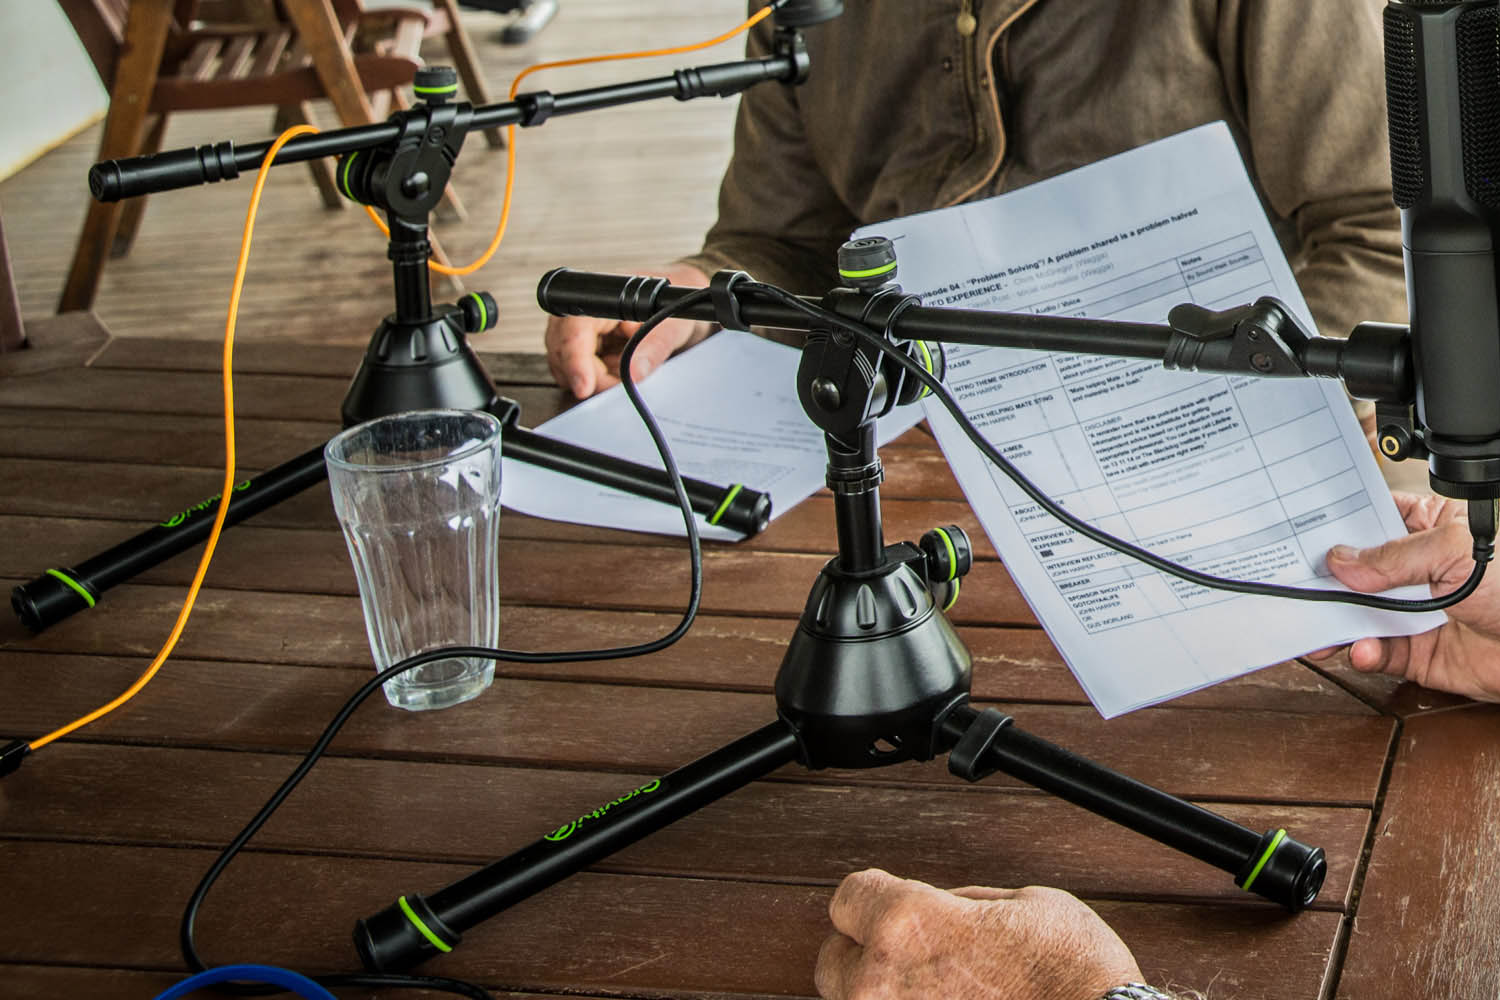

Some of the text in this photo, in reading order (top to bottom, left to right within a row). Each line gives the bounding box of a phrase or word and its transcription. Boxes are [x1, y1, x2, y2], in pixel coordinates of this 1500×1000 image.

[918, 285, 948, 300] pisode
[948, 282, 960, 291] 04
[1053, 244, 1090, 261] problem
[1089, 234, 1119, 249] shared
[1135, 217, 1171, 235] problem
[1169, 207, 1199, 223] halved
[1180, 255, 1202, 266] Notes
[945, 281, 1003, 305] EXPERIENCE
[1035, 304, 1056, 315] Audio
[1061, 297, 1081, 307] Voice
[948, 359, 971, 370] EASER
[953, 362, 1047, 393] INTRO THEME INTRODUCTION
[985, 405, 1014, 418] HELPING
[1014, 400, 1033, 409] MATE
[1032, 394, 1054, 404] STING
[1030, 531, 1064, 543] INTERVIEW
[1033, 536, 1073, 550] EXPERIENCE
[1046, 558, 1081, 570] INTERVIEW
[1059, 578, 1090, 589] BREAKER
[1067, 590, 1099, 602] SPONSOR
[1099, 585, 1120, 594] SHOUT
